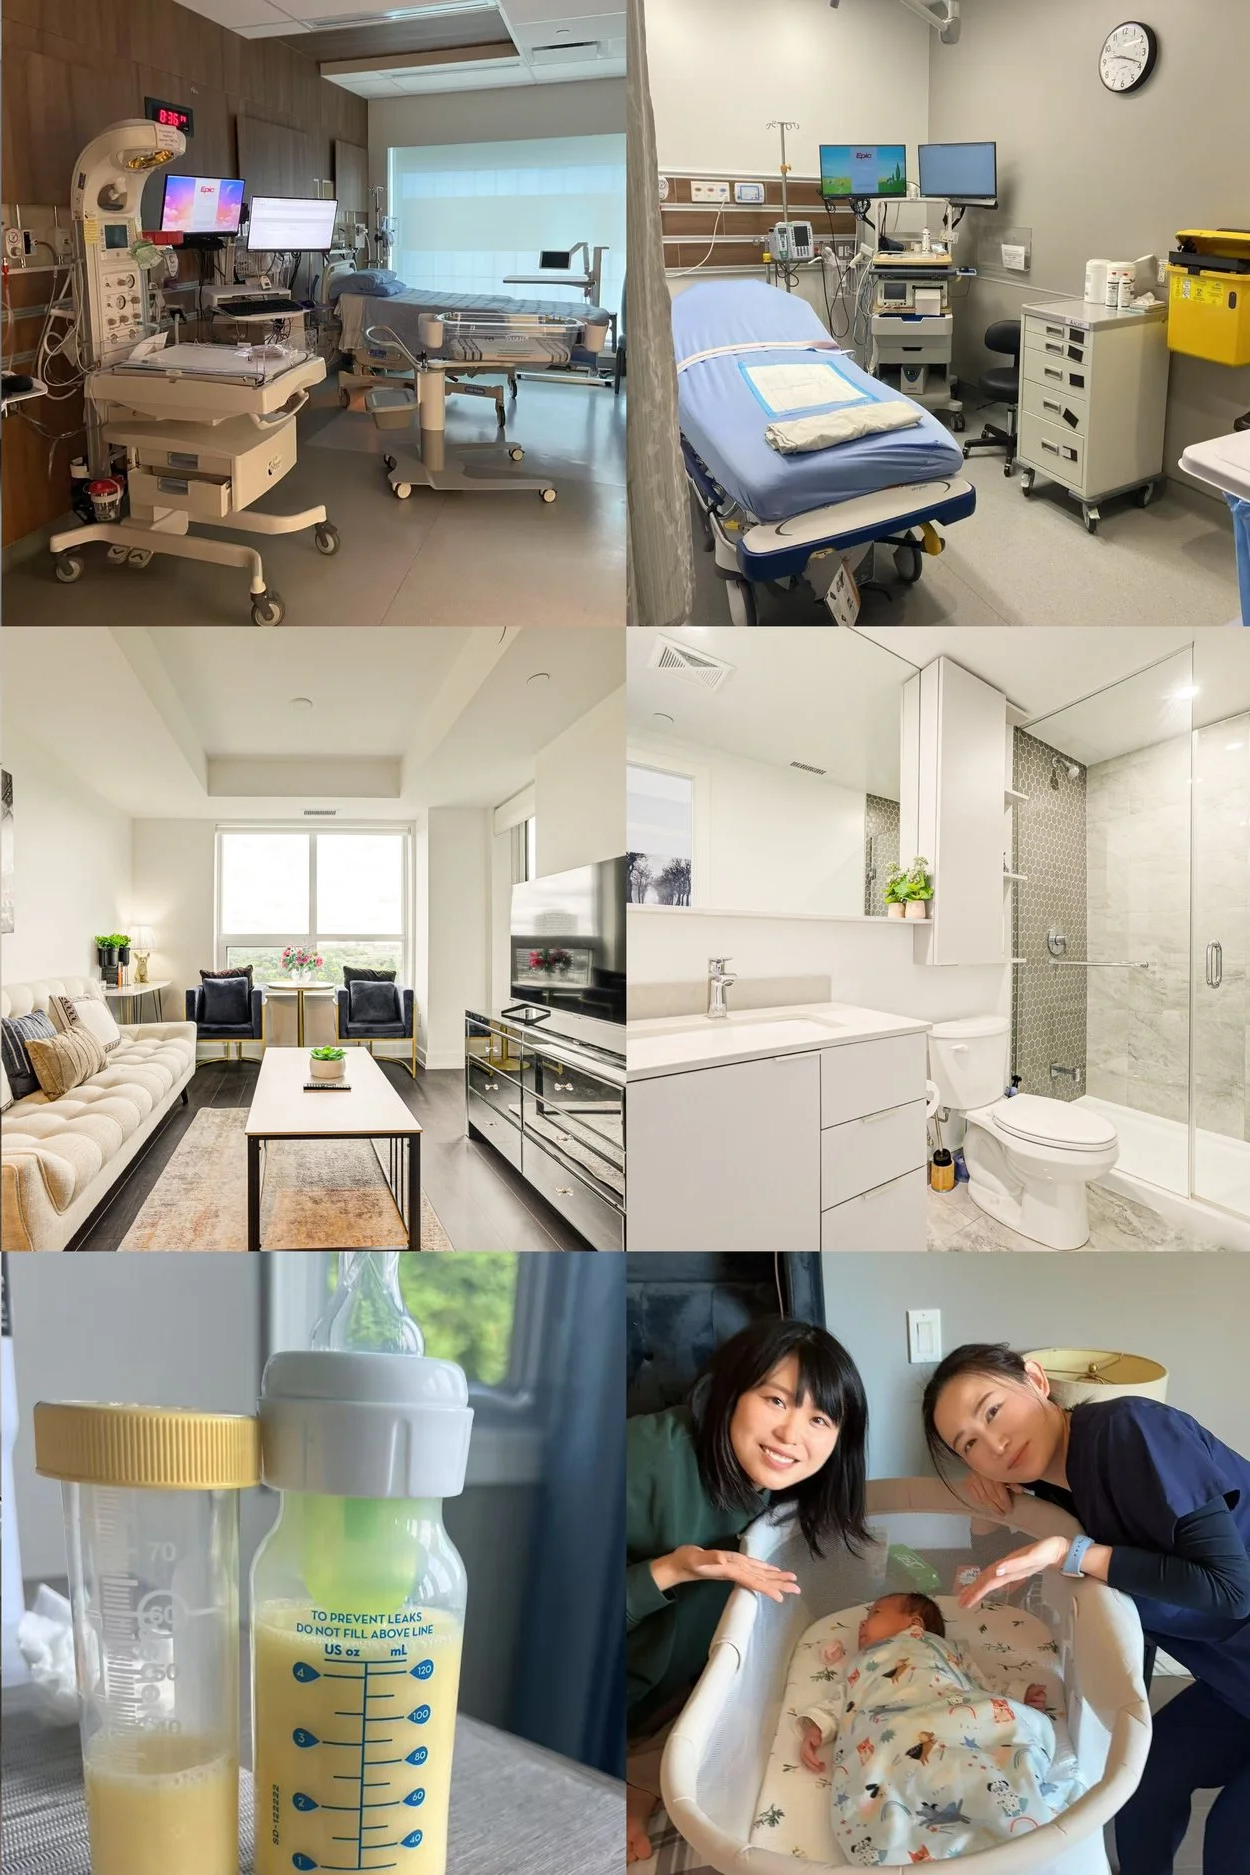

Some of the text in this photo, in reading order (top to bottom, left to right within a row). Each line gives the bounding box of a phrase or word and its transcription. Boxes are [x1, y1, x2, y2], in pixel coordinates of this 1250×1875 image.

[856, 152, 872, 160] Epic
[200, 186, 215, 194] Epic
[149, 1541, 177, 1562] 70
[311, 1610, 422, 1625] TO PREVENT LEAKS
[296, 1622, 434, 1639] DO NOT FILL ABOVE LINE
[324, 1644, 360, 1657] US oz
[390, 1644, 408, 1656] mL
[297, 1667, 305, 1678] 4
[418, 1664, 432, 1675] 120
[413, 1709, 429, 1721] 100
[298, 1732, 305, 1743] 3
[414, 1751, 426, 1761] 80
[412, 1791, 424, 1801] 60
[298, 1797, 305, 1808] 2
[409, 1833, 421, 1844] 40
[297, 1856, 302, 1866] 1
